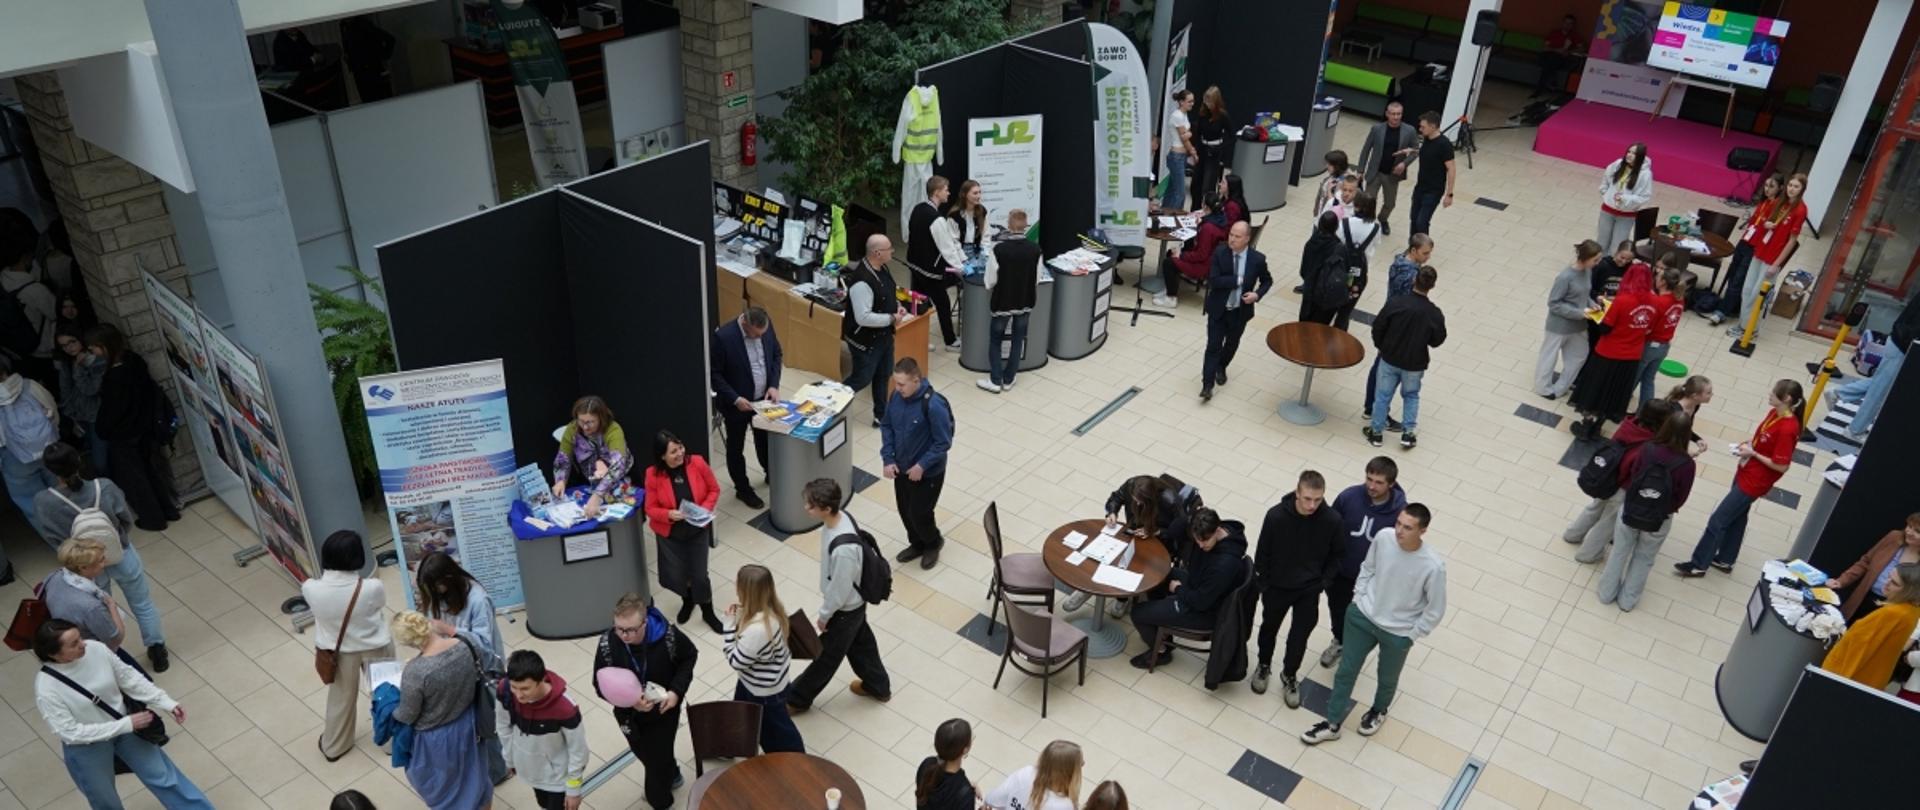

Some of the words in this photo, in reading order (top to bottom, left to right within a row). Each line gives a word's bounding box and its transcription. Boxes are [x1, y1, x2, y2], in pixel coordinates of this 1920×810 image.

[1097, 46, 1127, 54] ZAWO
[1097, 53, 1127, 61] DOWO!
[1105, 86, 1118, 144] BLISKO
[1119, 86, 1133, 165] UCZELNIA
[1108, 148, 1119, 199] CIEBIE
[407, 399, 436, 411] NASZE
[437, 397, 466, 407] ATUTY
